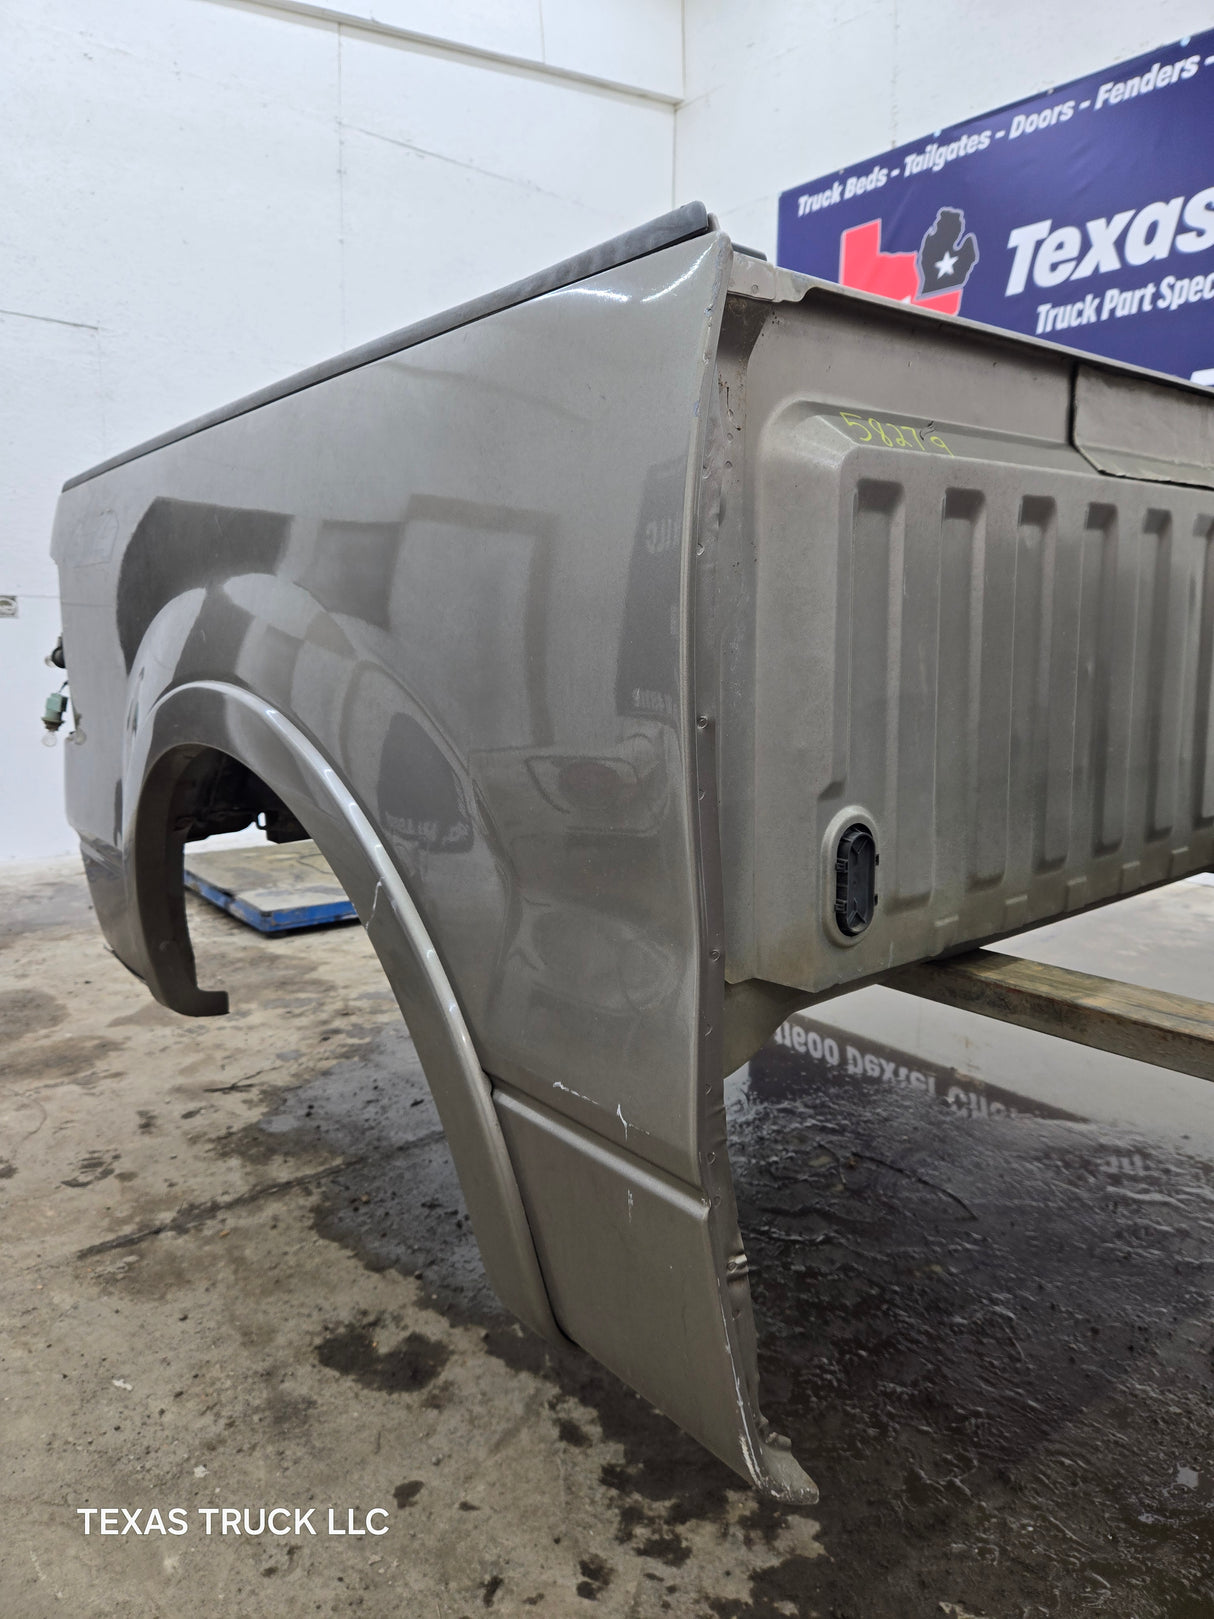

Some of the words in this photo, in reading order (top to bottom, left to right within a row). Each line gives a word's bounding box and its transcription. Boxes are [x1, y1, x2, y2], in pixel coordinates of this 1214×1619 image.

[798, 180, 843, 217] Truck
[844, 165, 889, 200] Beds
[904, 130, 992, 177] Tailgates
[1008, 100, 1076, 140] Doors
[1094, 55, 1200, 111] Fenders
[1004, 187, 1214, 297] Texas
[1036, 293, 1100, 335] Truck
[1101, 282, 1156, 321] Part
